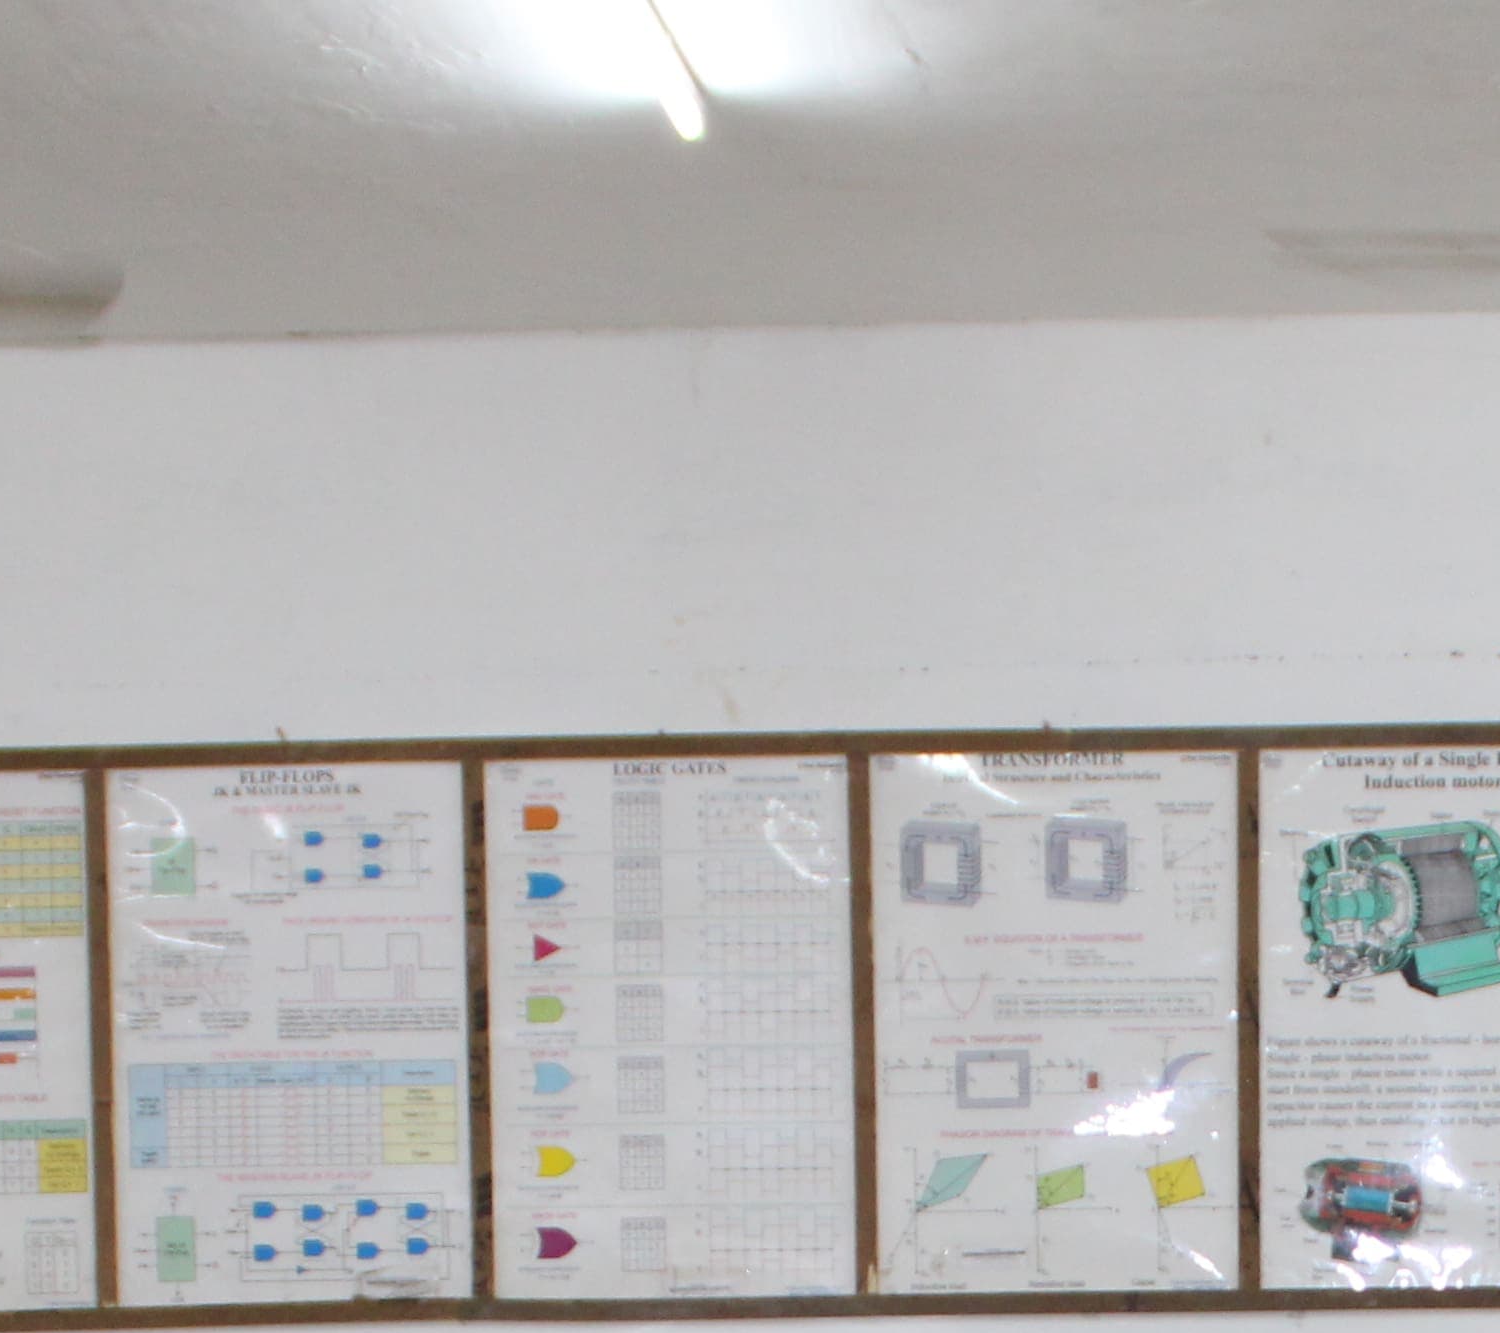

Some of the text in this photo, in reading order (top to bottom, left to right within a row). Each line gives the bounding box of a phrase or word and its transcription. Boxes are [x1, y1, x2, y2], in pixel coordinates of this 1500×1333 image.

[981, 753, 1124, 768] TRANSFORMER
[1323, 753, 1395, 769] Cutaway
[1402, 752, 1418, 766] of
[1424, 756, 1433, 766] a
[1439, 751, 1490, 768] Single
[614, 761, 726, 775] LOGIC GATES
[240, 770, 334, 784] FLIP-FLOPS
[1365, 775, 1444, 789] Induction
[246, 786, 297, 795] MASTER
